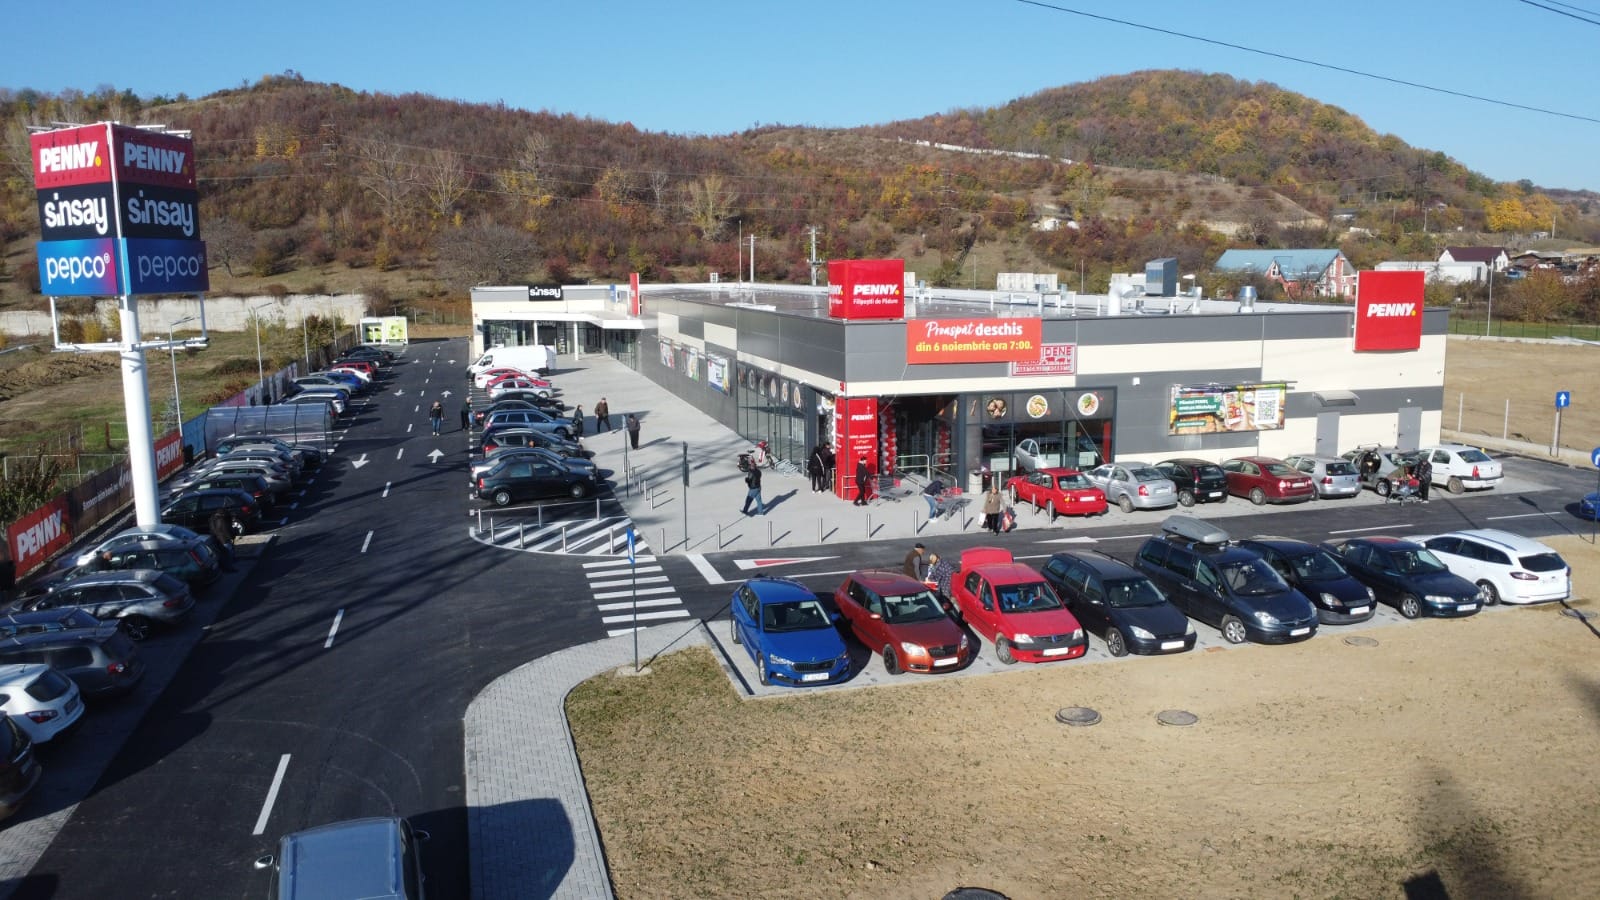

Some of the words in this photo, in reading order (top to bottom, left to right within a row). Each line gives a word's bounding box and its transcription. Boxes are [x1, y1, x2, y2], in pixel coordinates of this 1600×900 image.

[44, 193, 108, 235] sinsay
[128, 190, 194, 237] sinsay
[530, 286, 560, 298] sinsay
[975, 322, 1023, 336] deschis
[915, 341, 932, 352] din
[933, 342, 940, 352] 6
[941, 341, 991, 352] noiembrie
[991, 342, 1008, 351] ora
[1010, 340, 1033, 350] 7:00.
